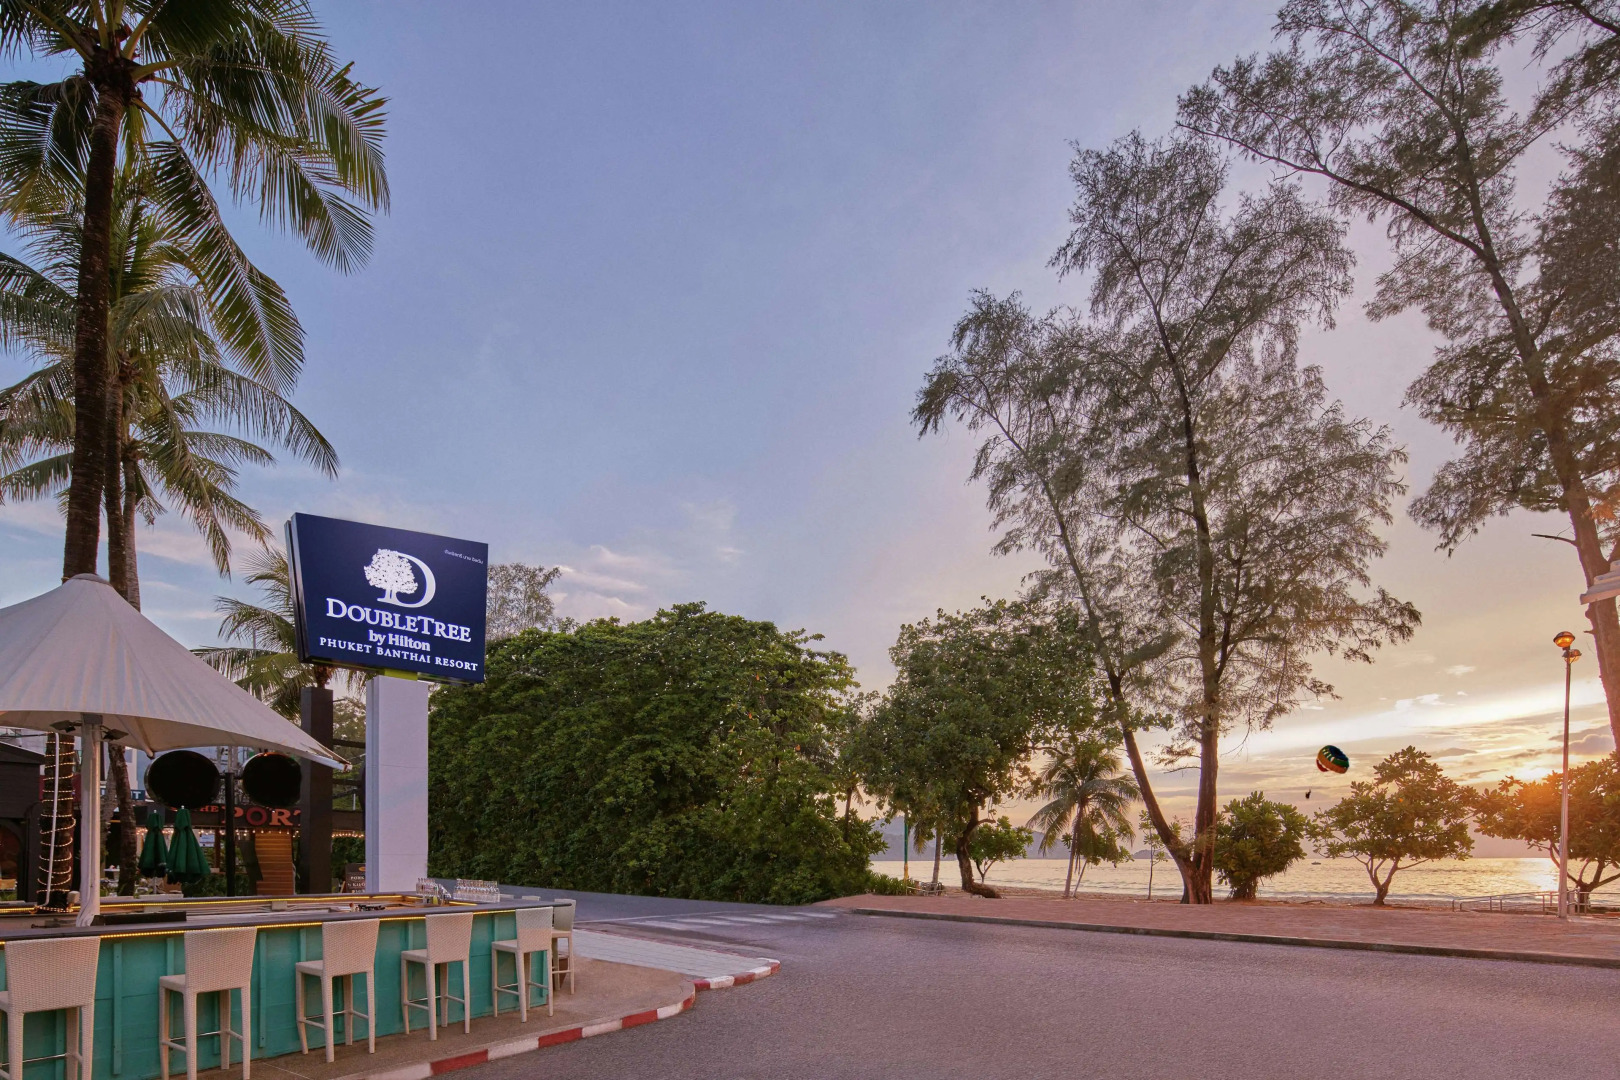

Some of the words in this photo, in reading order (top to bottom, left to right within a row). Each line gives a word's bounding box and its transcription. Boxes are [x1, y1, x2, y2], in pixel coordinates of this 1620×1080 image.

[319, 637, 372, 654] PHUKET
[376, 647, 431, 664] BANTHAI
[435, 656, 478, 671] RESORT
[368, 630, 387, 646] by
[388, 633, 431, 651] Hilton
